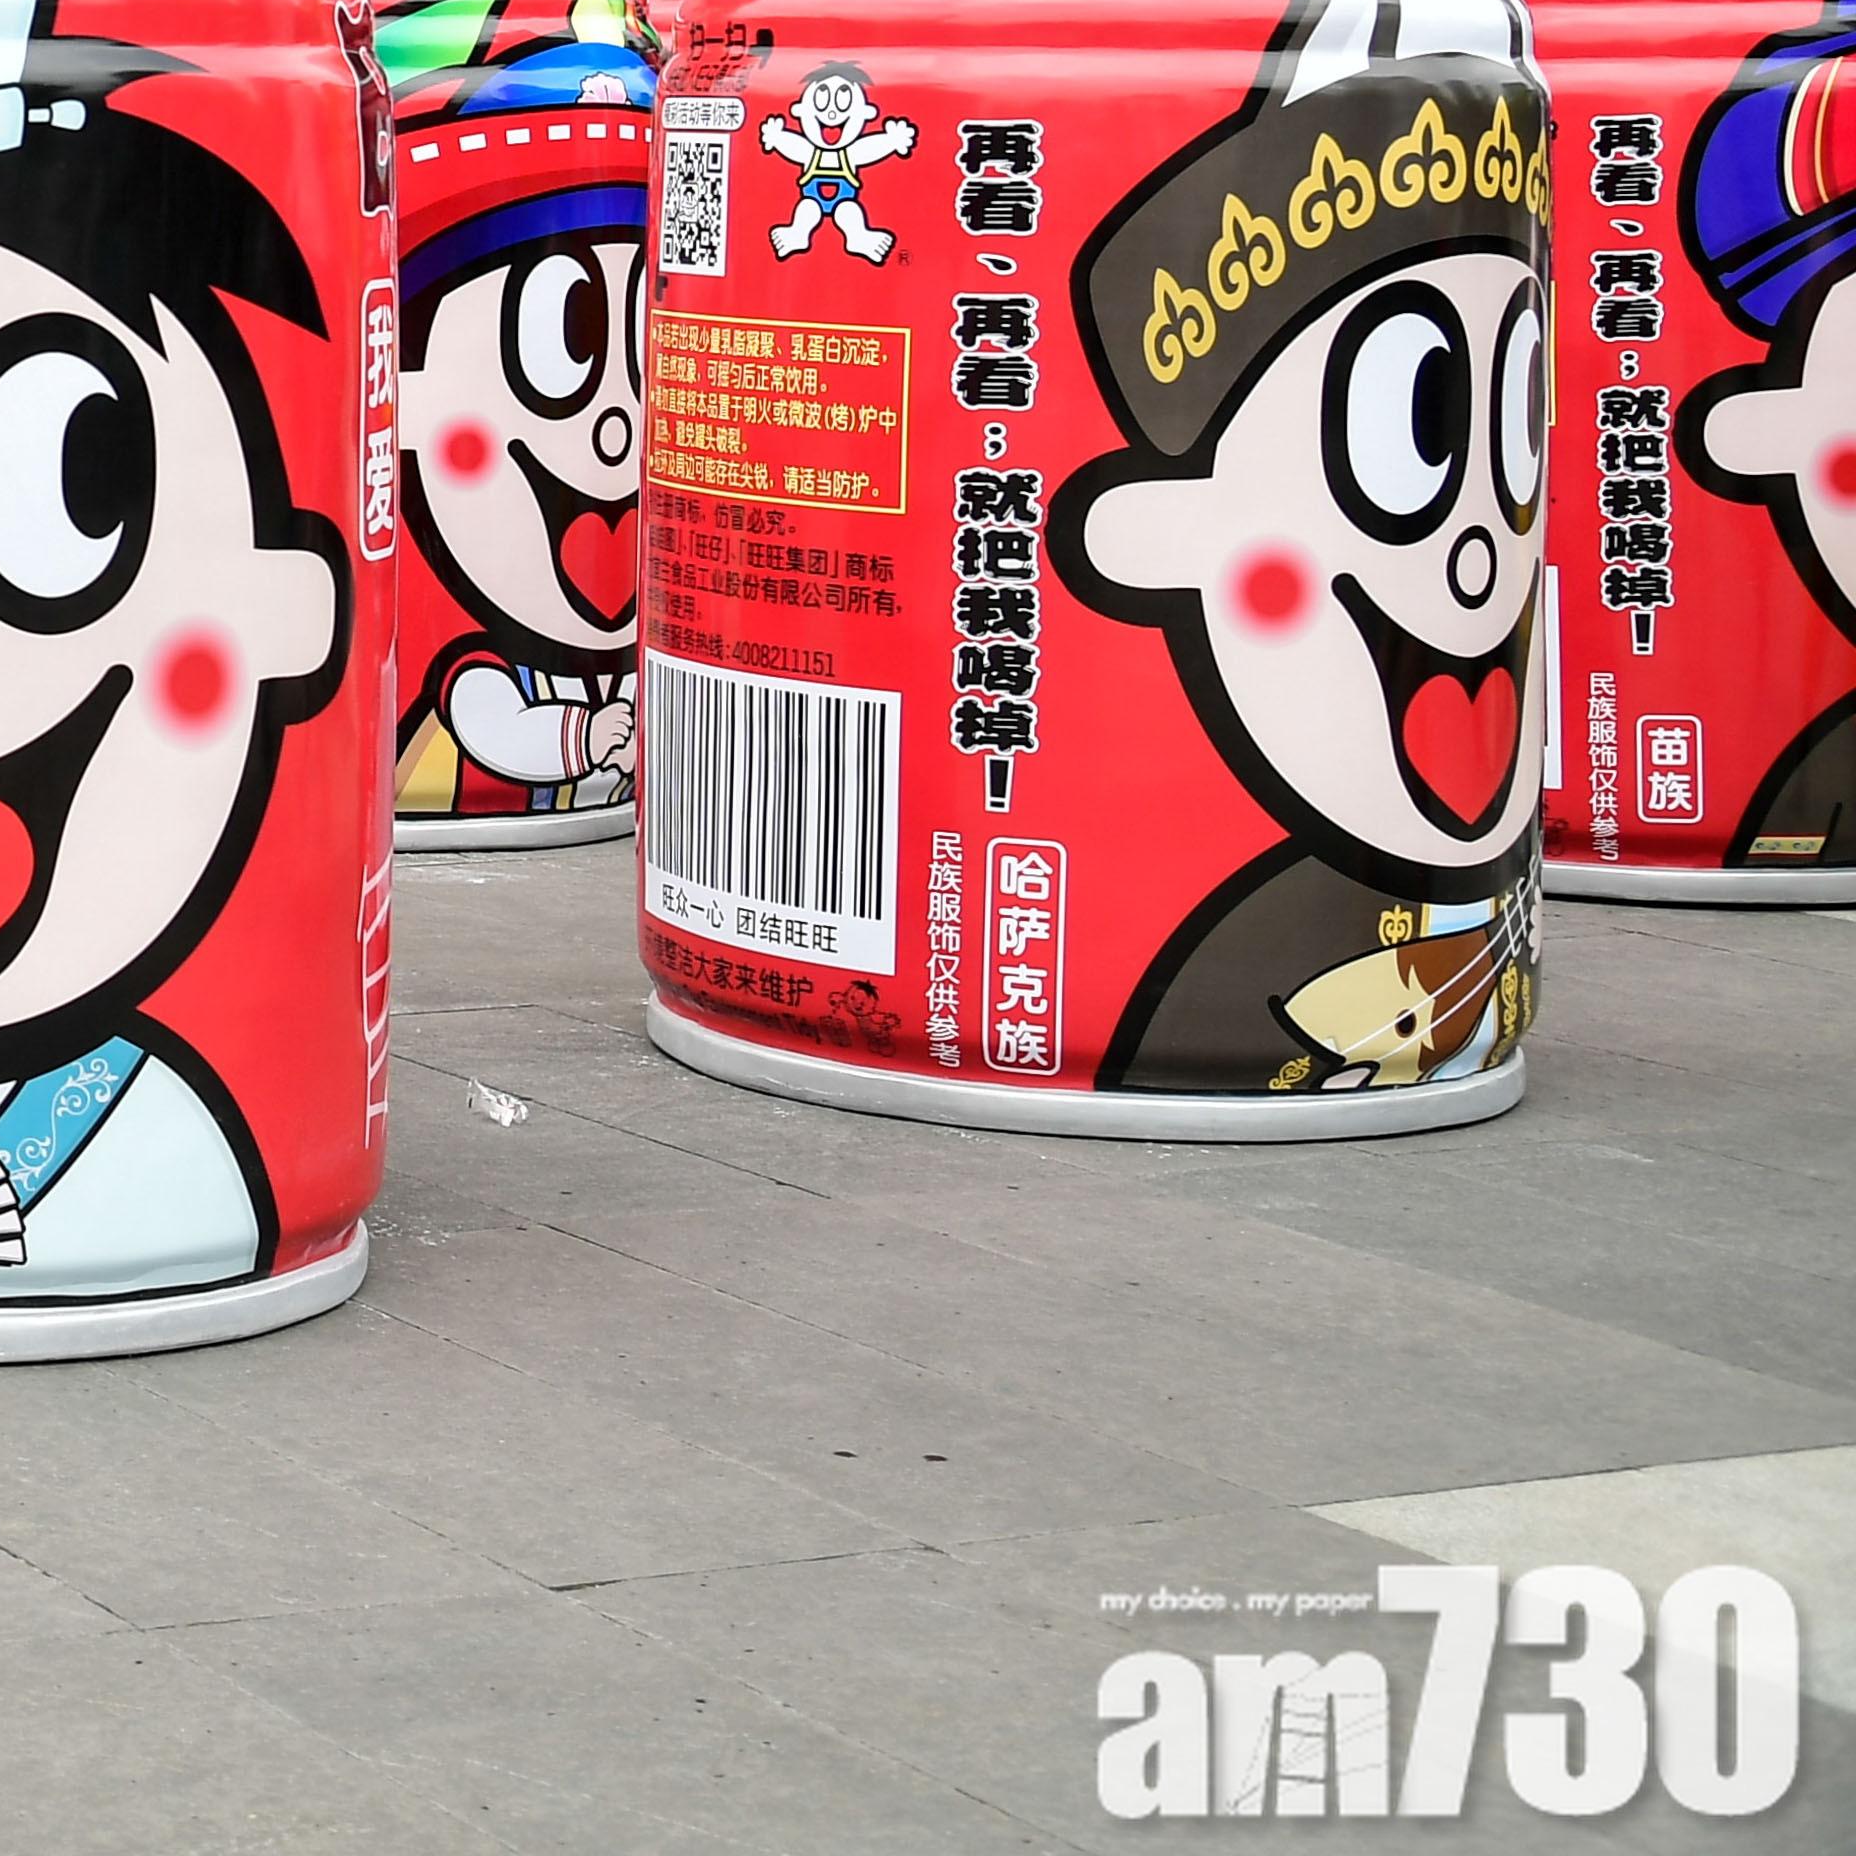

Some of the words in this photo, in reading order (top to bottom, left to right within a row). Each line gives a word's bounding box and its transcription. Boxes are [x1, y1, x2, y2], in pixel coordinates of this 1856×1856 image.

[364, 301, 394, 538] 我爱
[1586, 671, 1620, 863] 民族服饰仅供参考
[1646, 726, 1696, 815] 苗族
[661, 882, 725, 930] 旺众一心
[736, 906, 840, 955] 团结旺旺
[925, 831, 965, 1069] 民族服饰仅供参考
[994, 849, 1055, 1069] 哈萨克族
